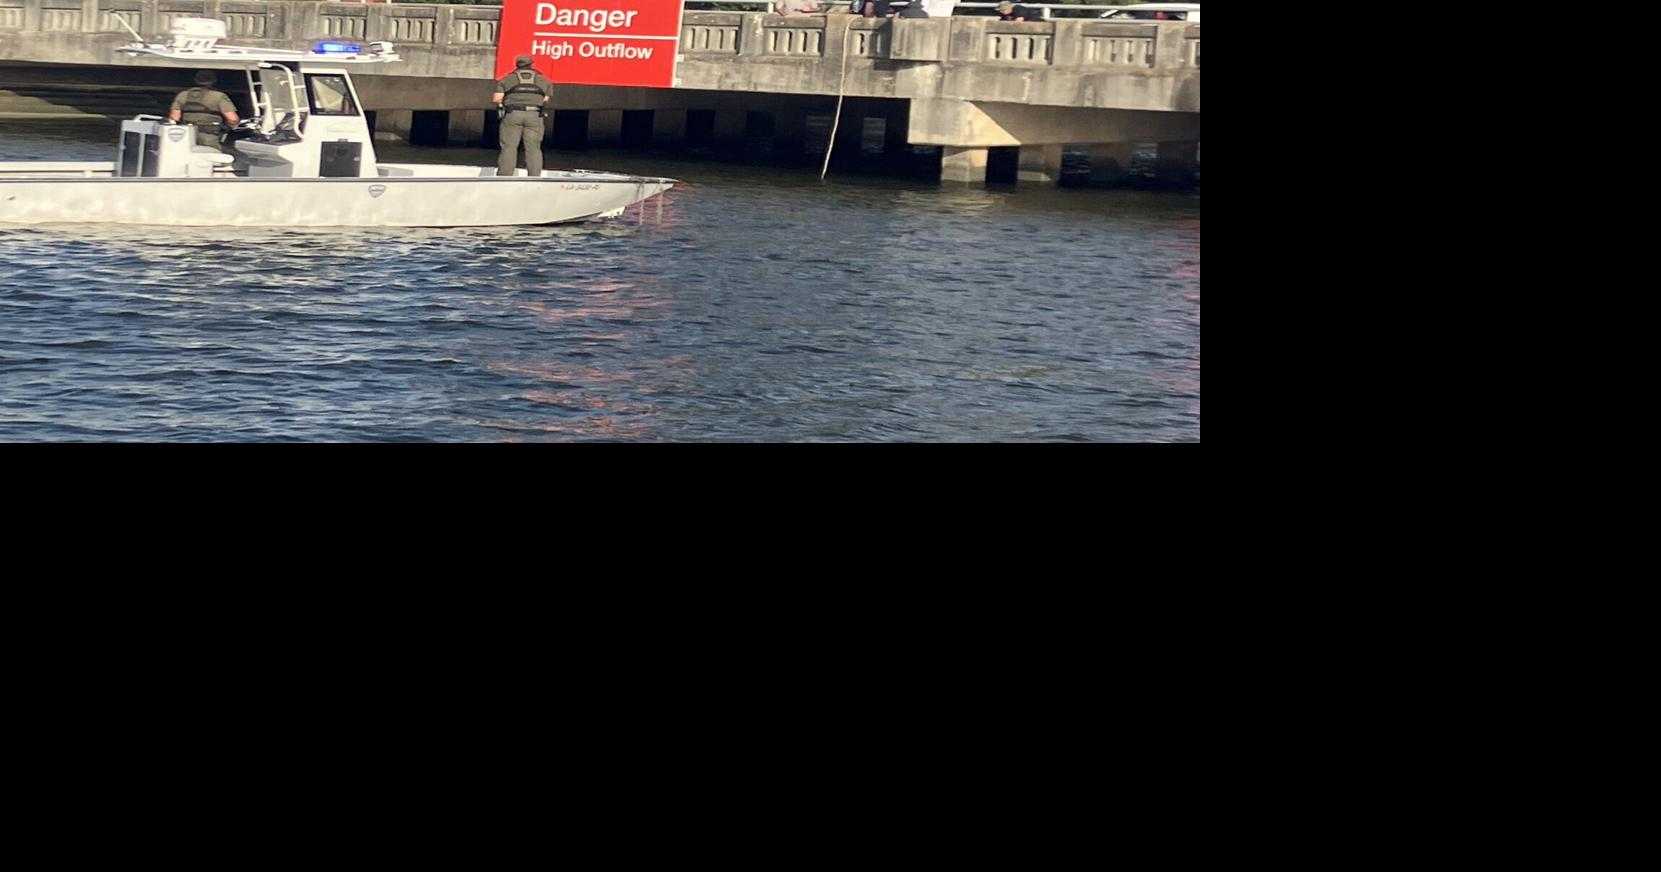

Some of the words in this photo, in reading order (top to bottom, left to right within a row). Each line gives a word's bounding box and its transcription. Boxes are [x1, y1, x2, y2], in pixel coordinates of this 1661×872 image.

[535, 3, 638, 32] Danger
[531, 40, 573, 60] High
[579, 41, 653, 60] Outflow
